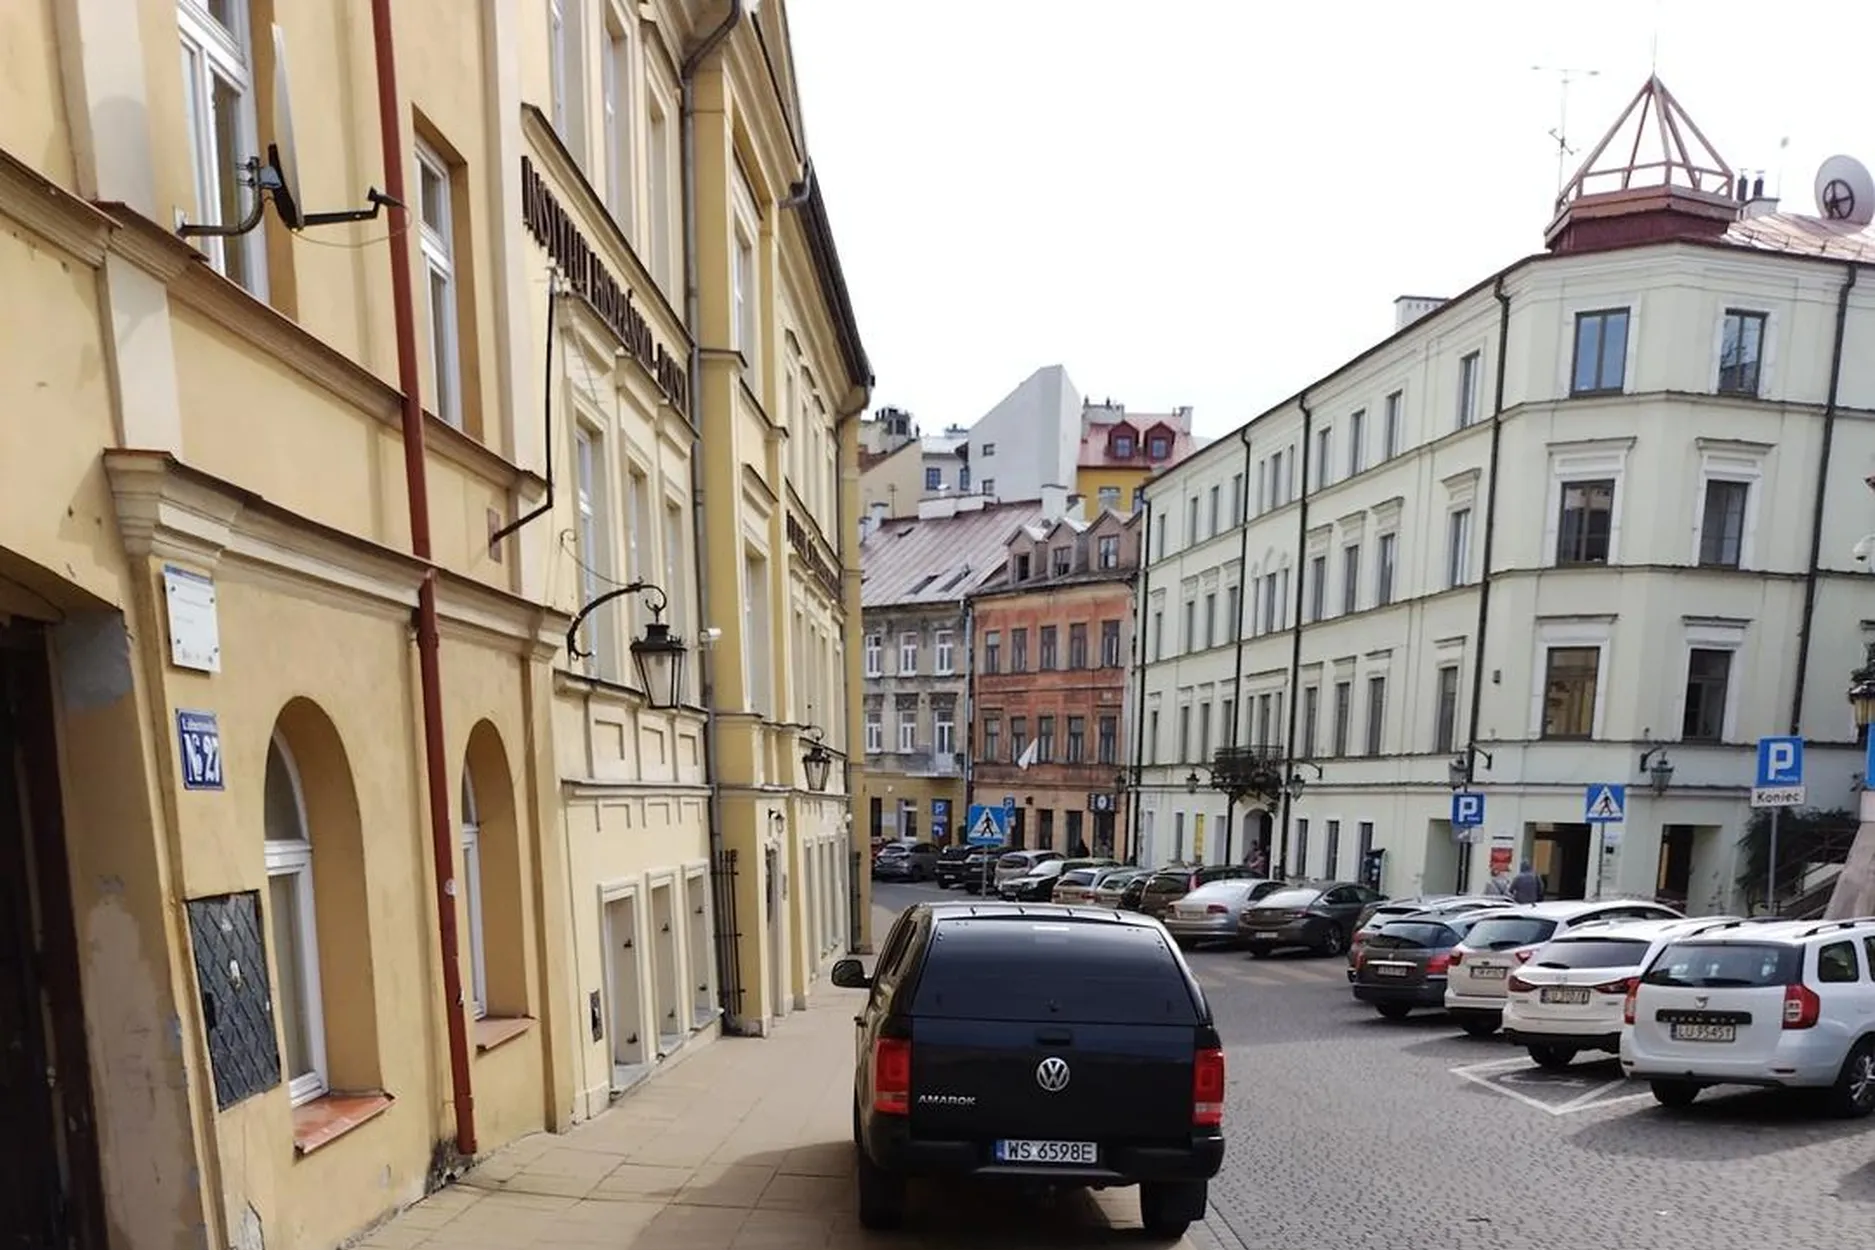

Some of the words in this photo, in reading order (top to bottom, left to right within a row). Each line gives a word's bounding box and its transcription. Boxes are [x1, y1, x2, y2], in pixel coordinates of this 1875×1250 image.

[1767, 742, 1794, 780] P
[1756, 791, 1800, 804] Koniec
[1458, 796, 1478, 822] P
[917, 1094, 976, 1106] AMAROK
[1007, 1141, 1031, 1159] WS
[1037, 1143, 1093, 1161] 6598E
